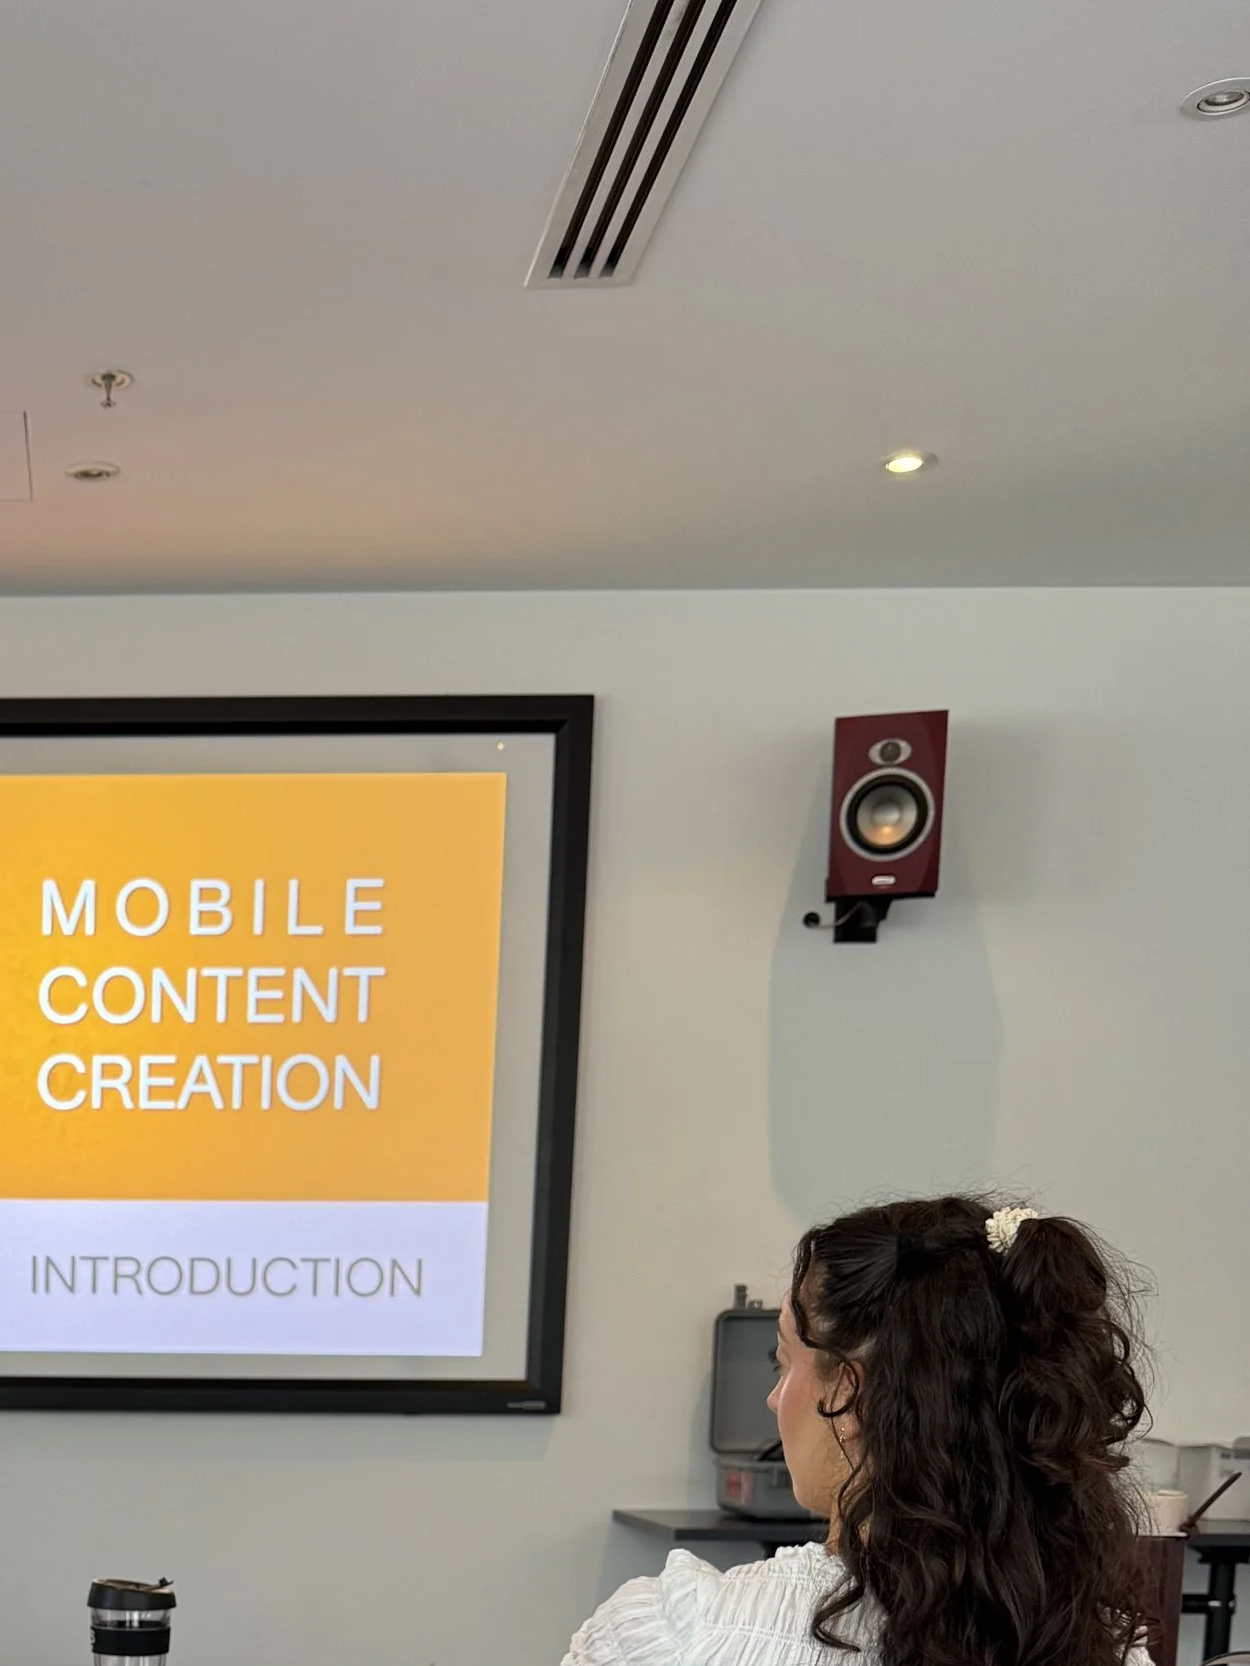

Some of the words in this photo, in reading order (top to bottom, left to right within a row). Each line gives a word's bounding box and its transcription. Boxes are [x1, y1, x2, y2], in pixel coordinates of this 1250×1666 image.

[40, 877, 385, 937] MOBILE
[38, 965, 385, 1027] CONTENT
[37, 1052, 381, 1112] CREATION
[30, 1256, 423, 1299] INTRODUCTION
